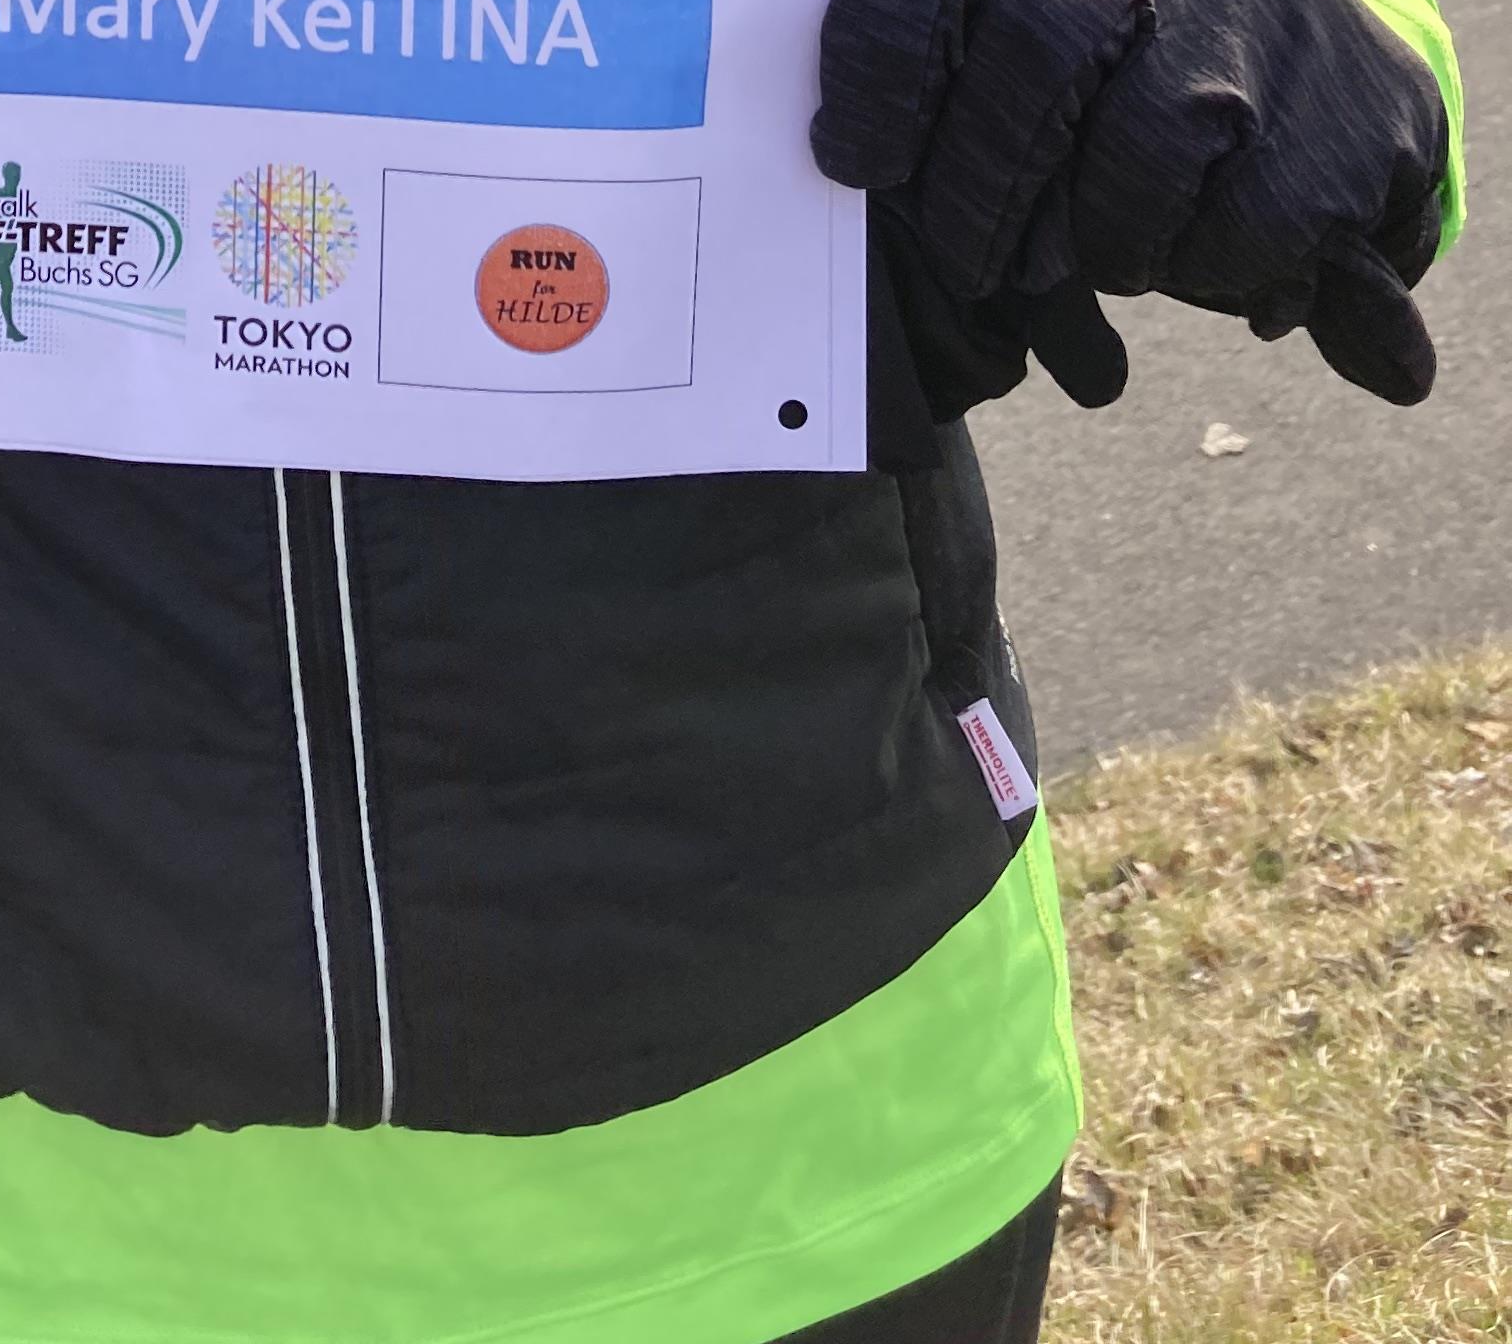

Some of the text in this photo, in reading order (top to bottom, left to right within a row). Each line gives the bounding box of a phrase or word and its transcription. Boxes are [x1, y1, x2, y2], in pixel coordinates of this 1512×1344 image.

[20, 257, 139, 288] Buchs SG
[510, 250, 576, 271] RUN
[532, 280, 556, 297] for
[496, 299, 593, 324] HILDE
[214, 315, 352, 353] TOKYO
[214, 353, 350, 379] MARATHON
